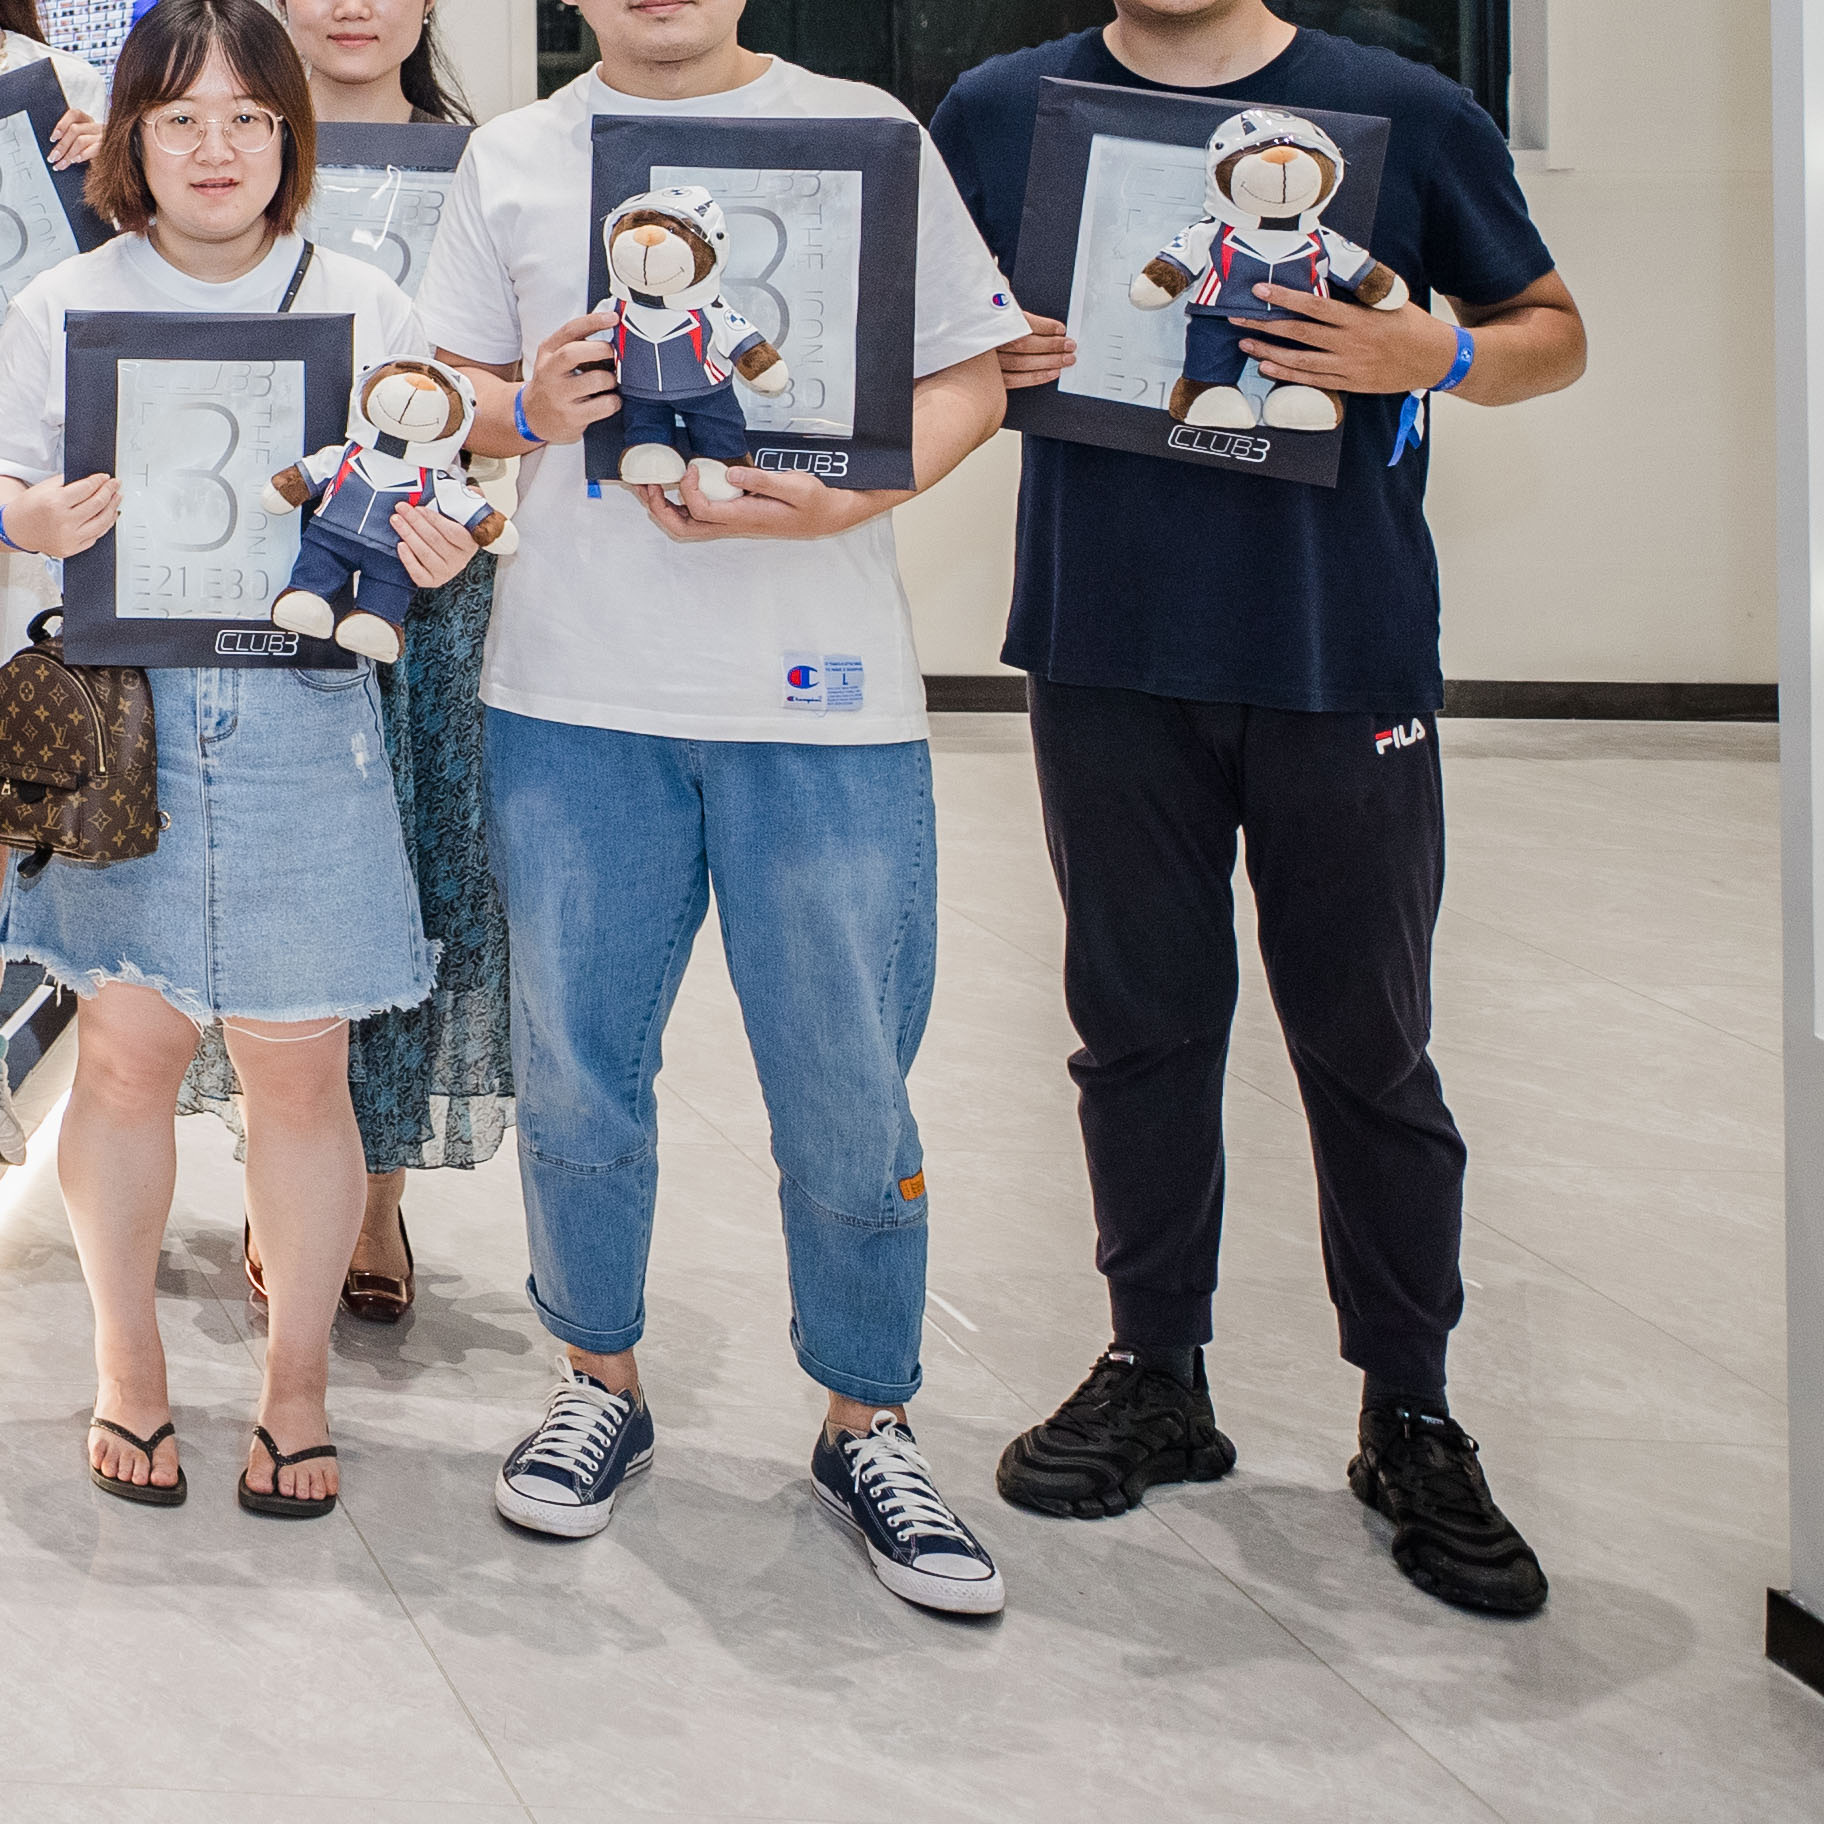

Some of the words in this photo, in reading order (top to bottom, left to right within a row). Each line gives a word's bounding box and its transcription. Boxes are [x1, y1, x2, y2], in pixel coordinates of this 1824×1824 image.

[1168, 424, 1271, 463] CLUB3
[755, 448, 850, 477] CLUB3
[215, 629, 299, 657] CLUB3
[1375, 717, 1426, 755] FILA
